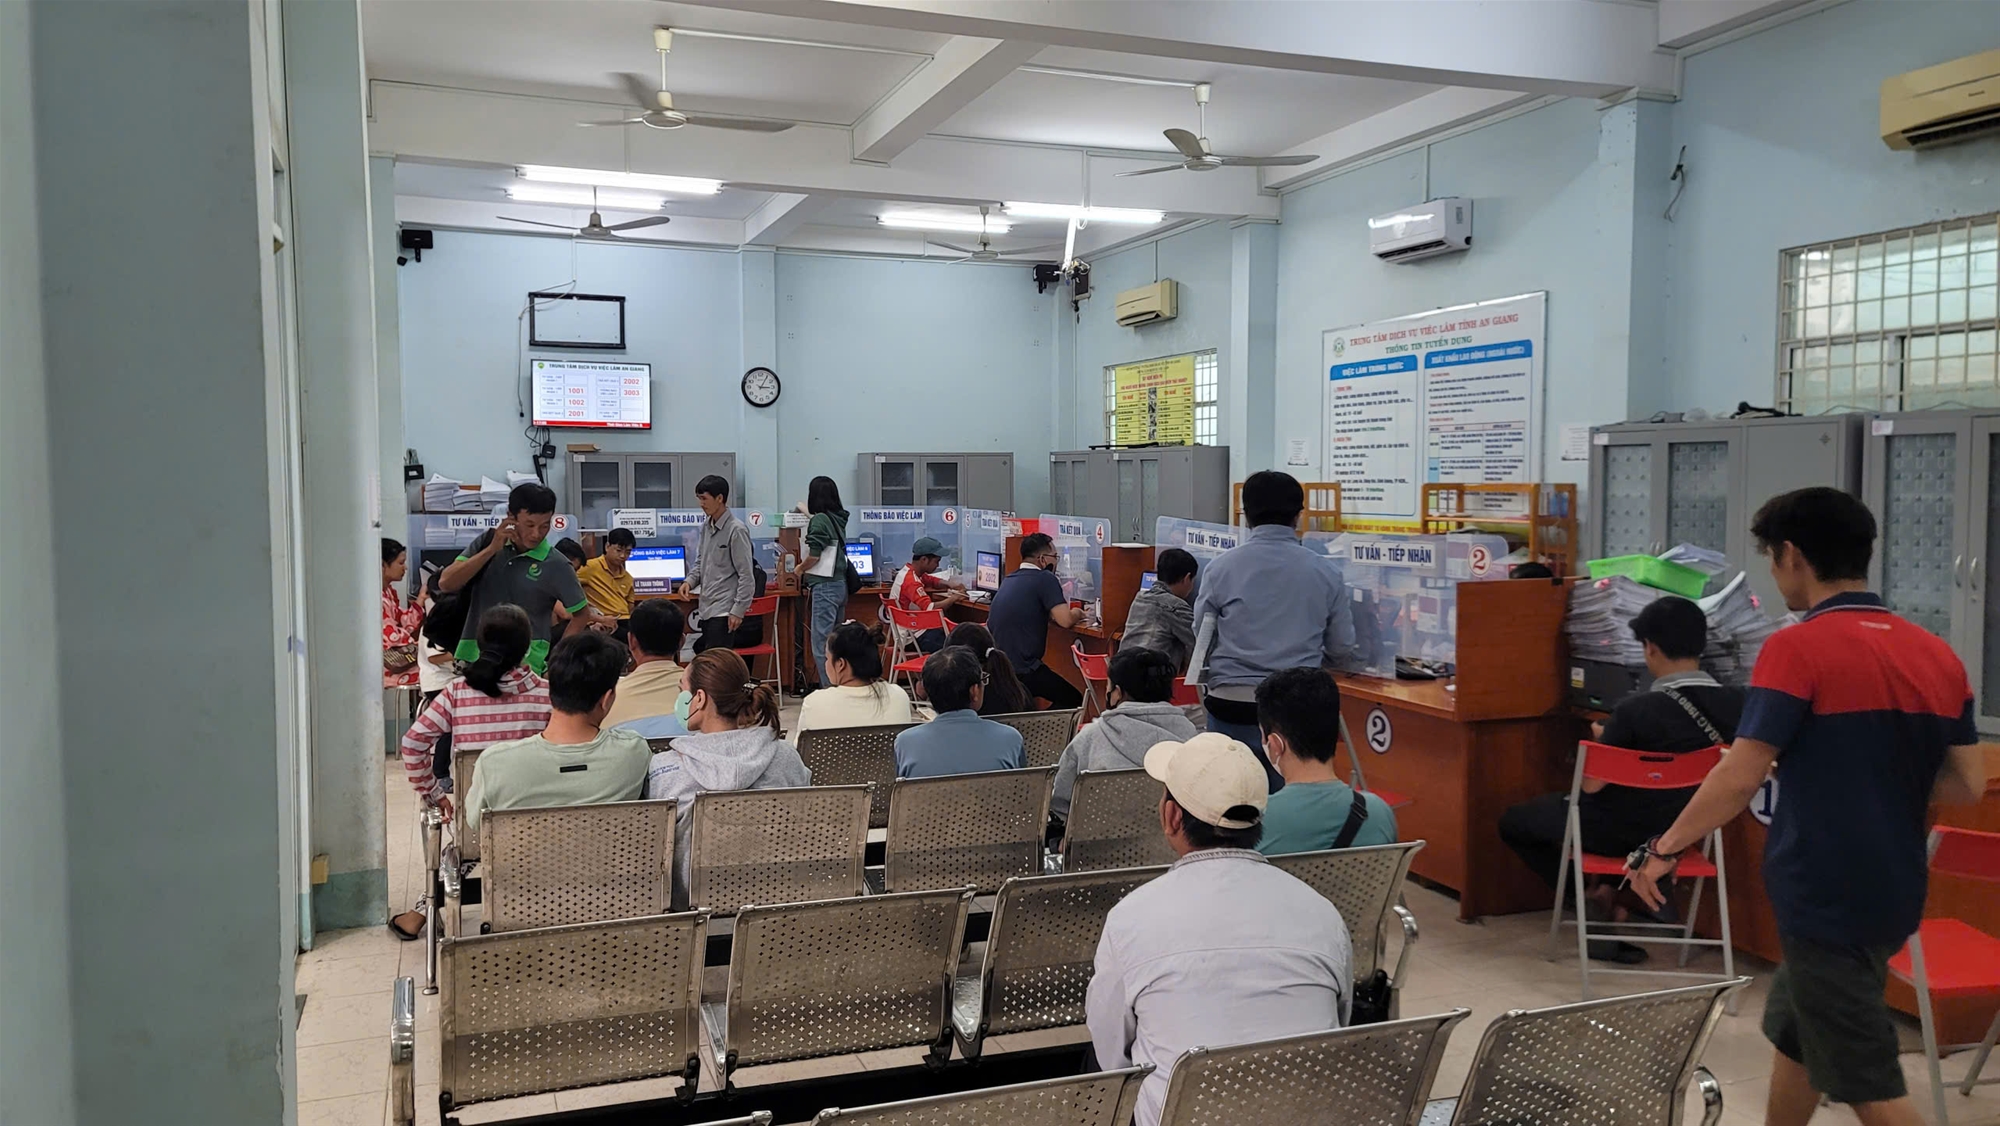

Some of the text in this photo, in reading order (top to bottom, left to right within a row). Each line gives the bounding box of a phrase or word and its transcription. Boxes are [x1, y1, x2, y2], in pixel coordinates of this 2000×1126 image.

[1350, 336, 1371, 346] TRUNG
[1373, 332, 1388, 342] TÂM
[1440, 322, 1456, 332] LÀM
[1479, 318, 1490, 328] AN
[1492, 314, 1518, 325] GIANG
[1411, 342, 1422, 351] TIN
[451, 517, 461, 526] TƯ
[463, 515, 477, 526] VẤN
[484, 515, 499, 526] TIẾP
[661, 513, 681, 523] THÔNG
[683, 513, 694, 523] BÁO
[751, 515, 760, 525] 7
[863, 510, 922, 521] THÔNG BÁO VIỆC LÀM
[945, 511, 953, 521] 6
[555, 518, 564, 528] 8
[1097, 526, 1102, 539] 4
[1188, 532, 1194, 543] TƯ
[1195, 531, 1204, 545] VẤN
[1209, 534, 1219, 547] TIẾP
[1354, 546, 1364, 559] TƯ
[1365, 542, 1380, 560] VẤN
[1388, 544, 1405, 561] TIẾP
[1408, 546, 1431, 566] NHẬN
[1473, 549, 1486, 570] 2
[853, 560, 864, 569] 03
[1371, 715, 1387, 747] 2
[1758, 780, 1772, 817] 1
